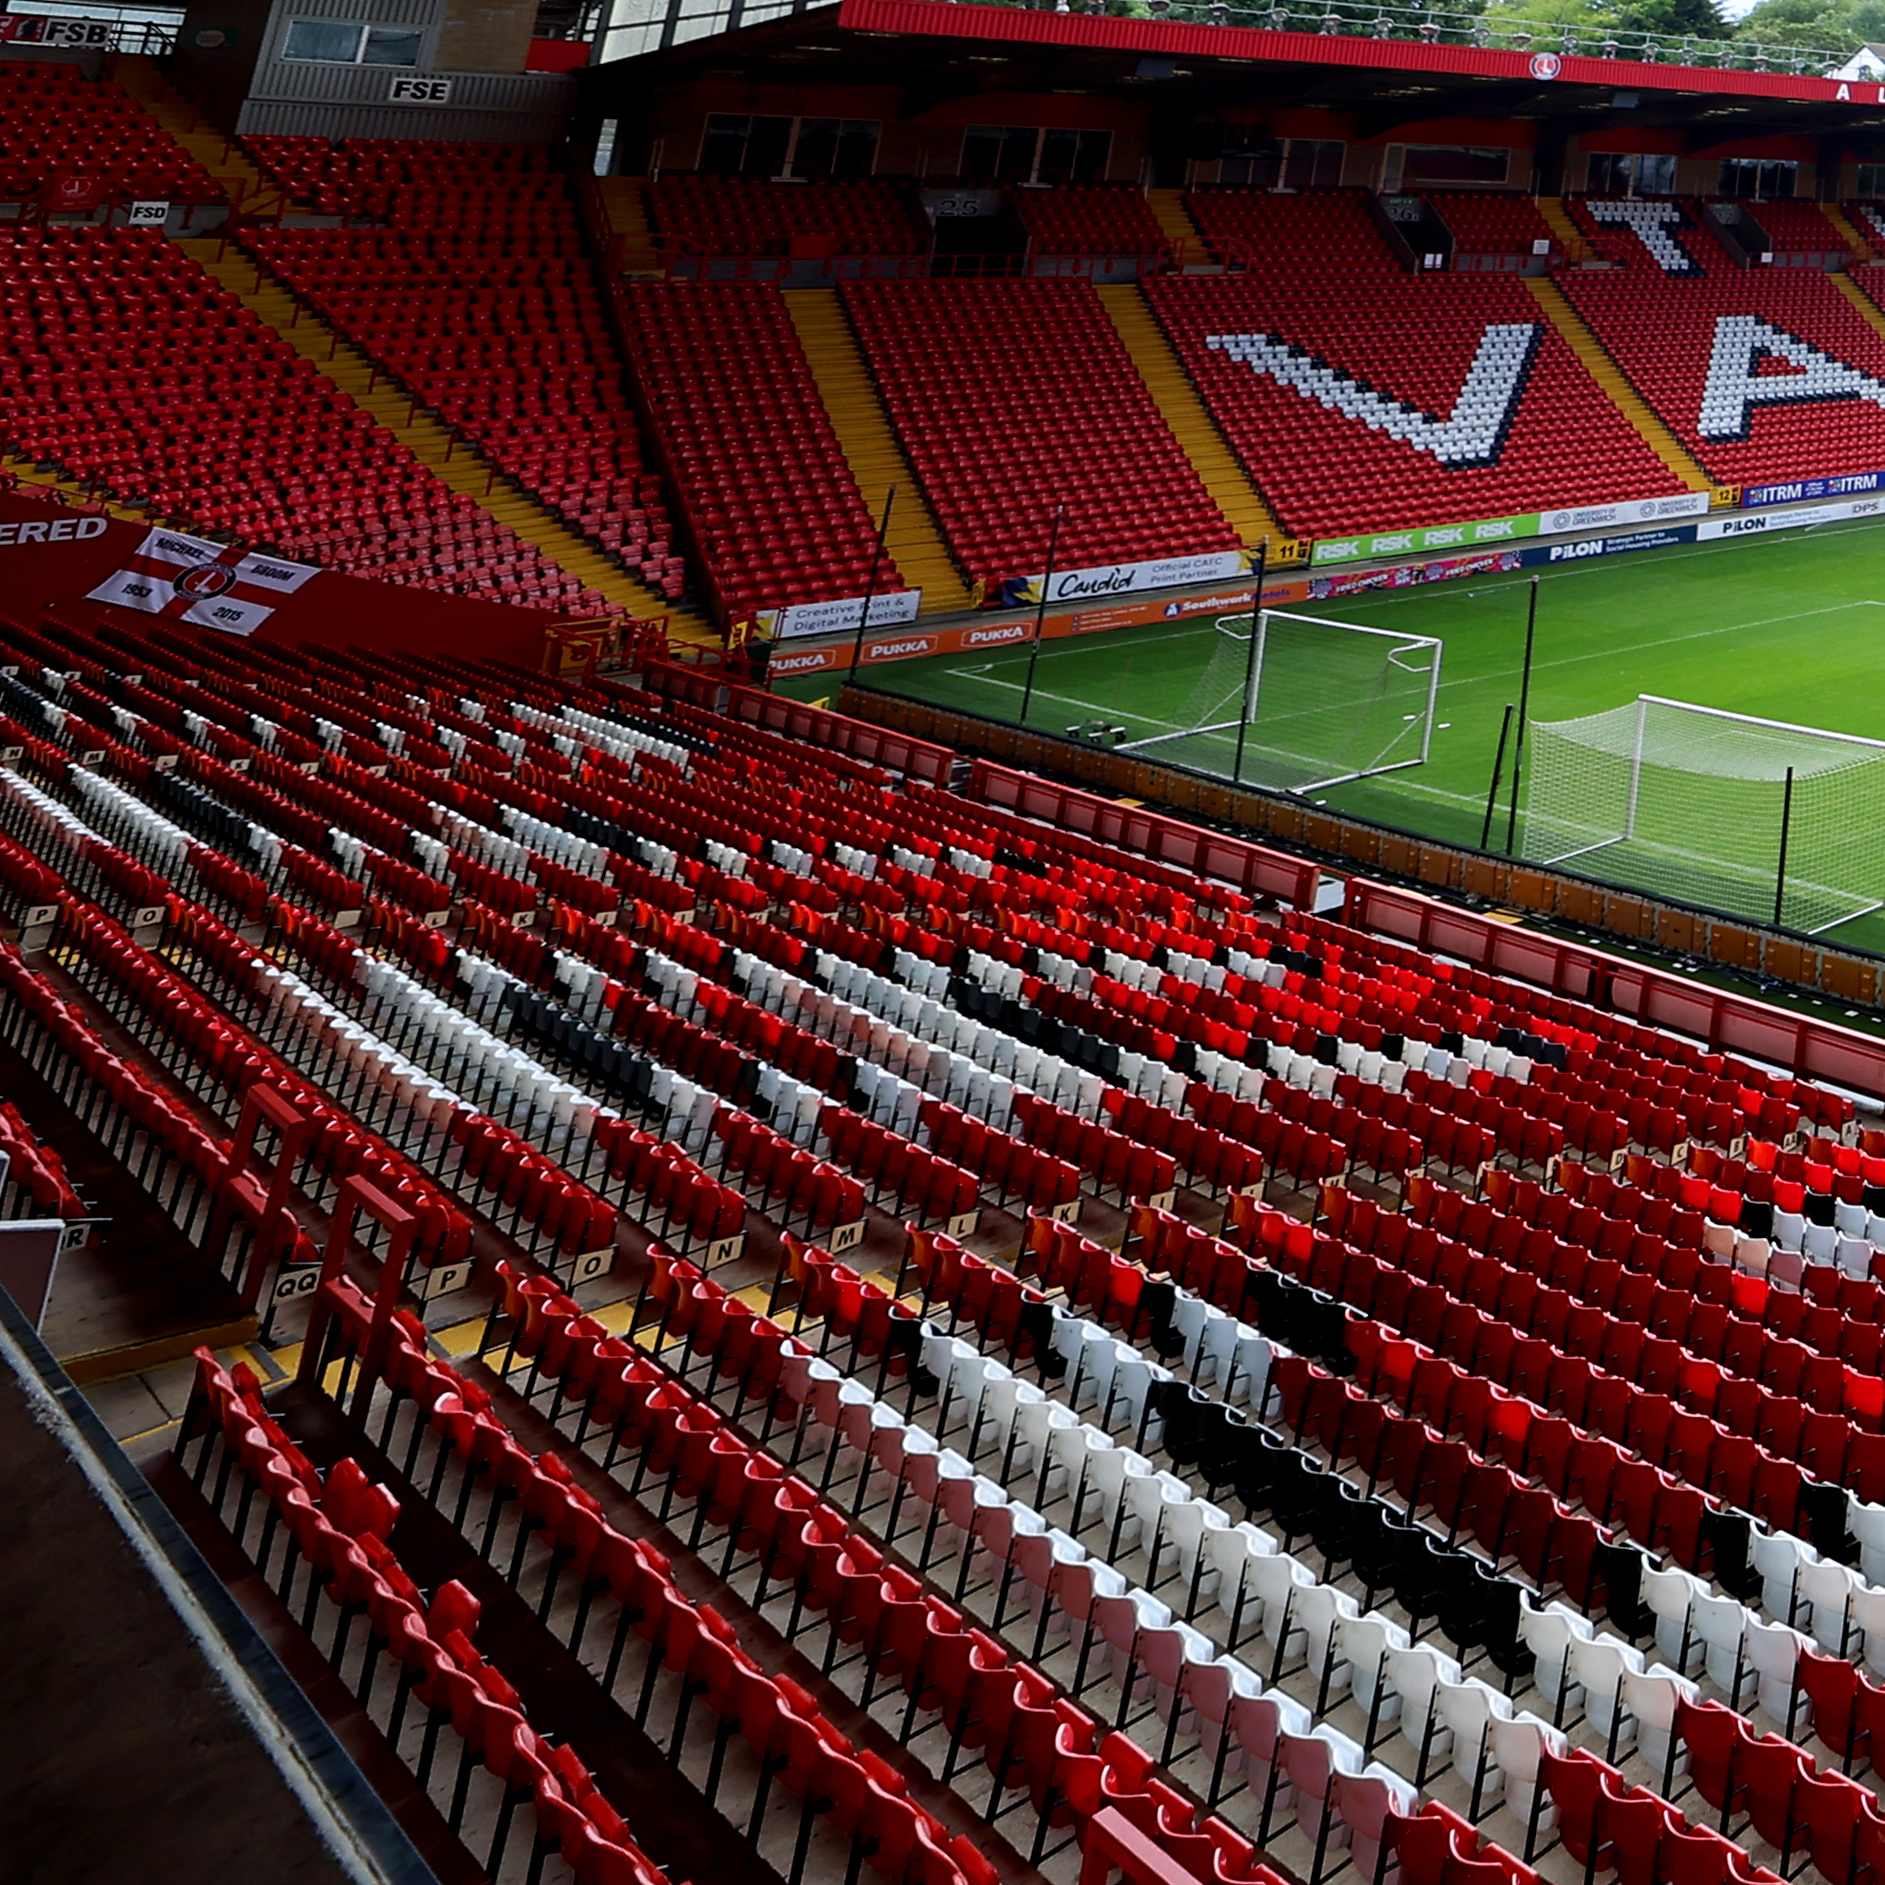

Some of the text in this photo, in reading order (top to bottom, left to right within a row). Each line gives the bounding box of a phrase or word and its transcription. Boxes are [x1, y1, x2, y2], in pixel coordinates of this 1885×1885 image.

[46, 21, 108, 44] FSB
[393, 80, 447, 102] FSE
[133, 206, 166, 219] FSD
[1841, 474, 1878, 492] ITRM
[1718, 490, 1731, 501] 12
[1762, 484, 1802, 502] ITRM
[1852, 502, 1880, 514] DPS
[1425, 528, 1464, 545] RSK
[1475, 521, 1514, 538] RSK
[1279, 545, 1295, 559] 11
[1316, 541, 1359, 560] RSK
[1371, 534, 1413, 553] RSK
[1550, 540, 1603, 561] PiLON
[1152, 559, 1191, 573] Official
[1057, 567, 1136, 598] Candid
[1150, 567, 1219, 584] Print Partner
[796, 601, 855, 618] Creative
[858, 598, 890, 611] Pint
[1183, 593, 1252, 612] Southwark
[211, 605, 245, 622] 2015
[793, 616, 839, 632] Digital
[969, 625, 1026, 643] PUKKA
[870, 640, 929, 658] PUKKA
[142, 909, 156, 922] O
[839, 1226, 856, 1245] M
[717, 1241, 733, 1261] N
[583, 1256, 601, 1275] O
[276, 1272, 317, 1298] QQ
[439, 1270, 458, 1290] P
